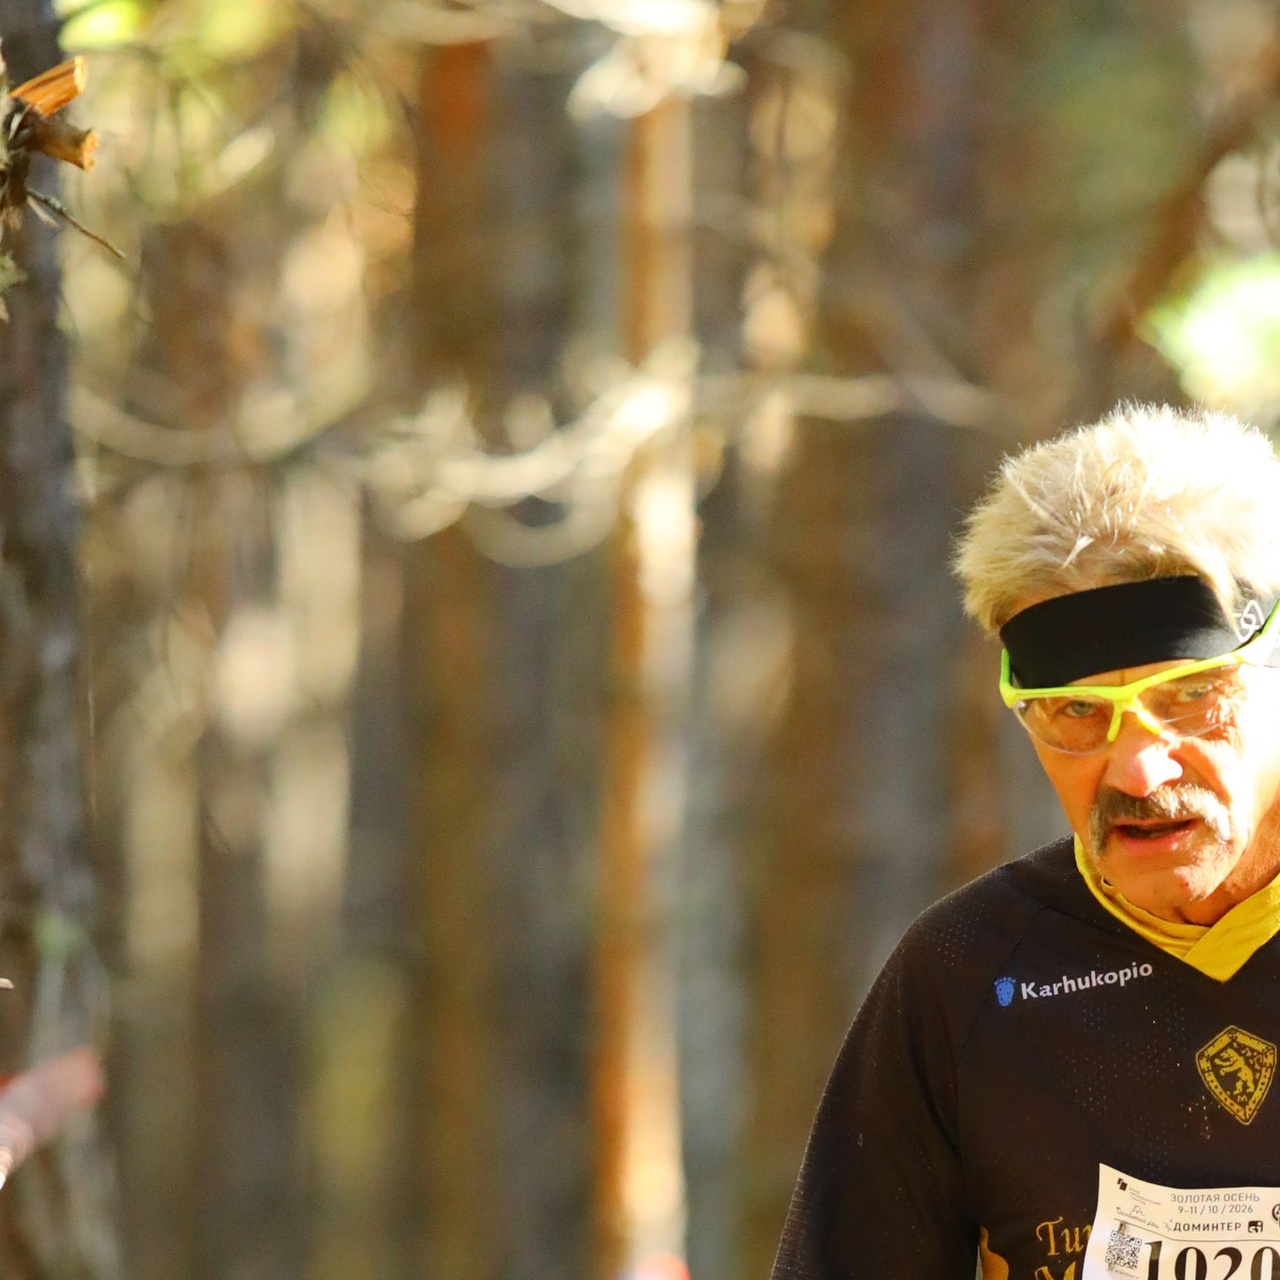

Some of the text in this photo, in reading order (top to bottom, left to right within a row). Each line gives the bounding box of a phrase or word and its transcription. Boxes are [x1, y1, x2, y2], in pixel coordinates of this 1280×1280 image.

[1020, 962, 1153, 1000] Karhukopio
[1170, 1194, 1220, 1204] ЗОЛОТАЯ
[1224, 1193, 1260, 1202] ОСЕНЬ
[1208, 1206, 1218, 1214] 10
[1229, 1204, 1253, 1214] 2026
[1173, 1222, 1242, 1232] ДОМИНТЕР
